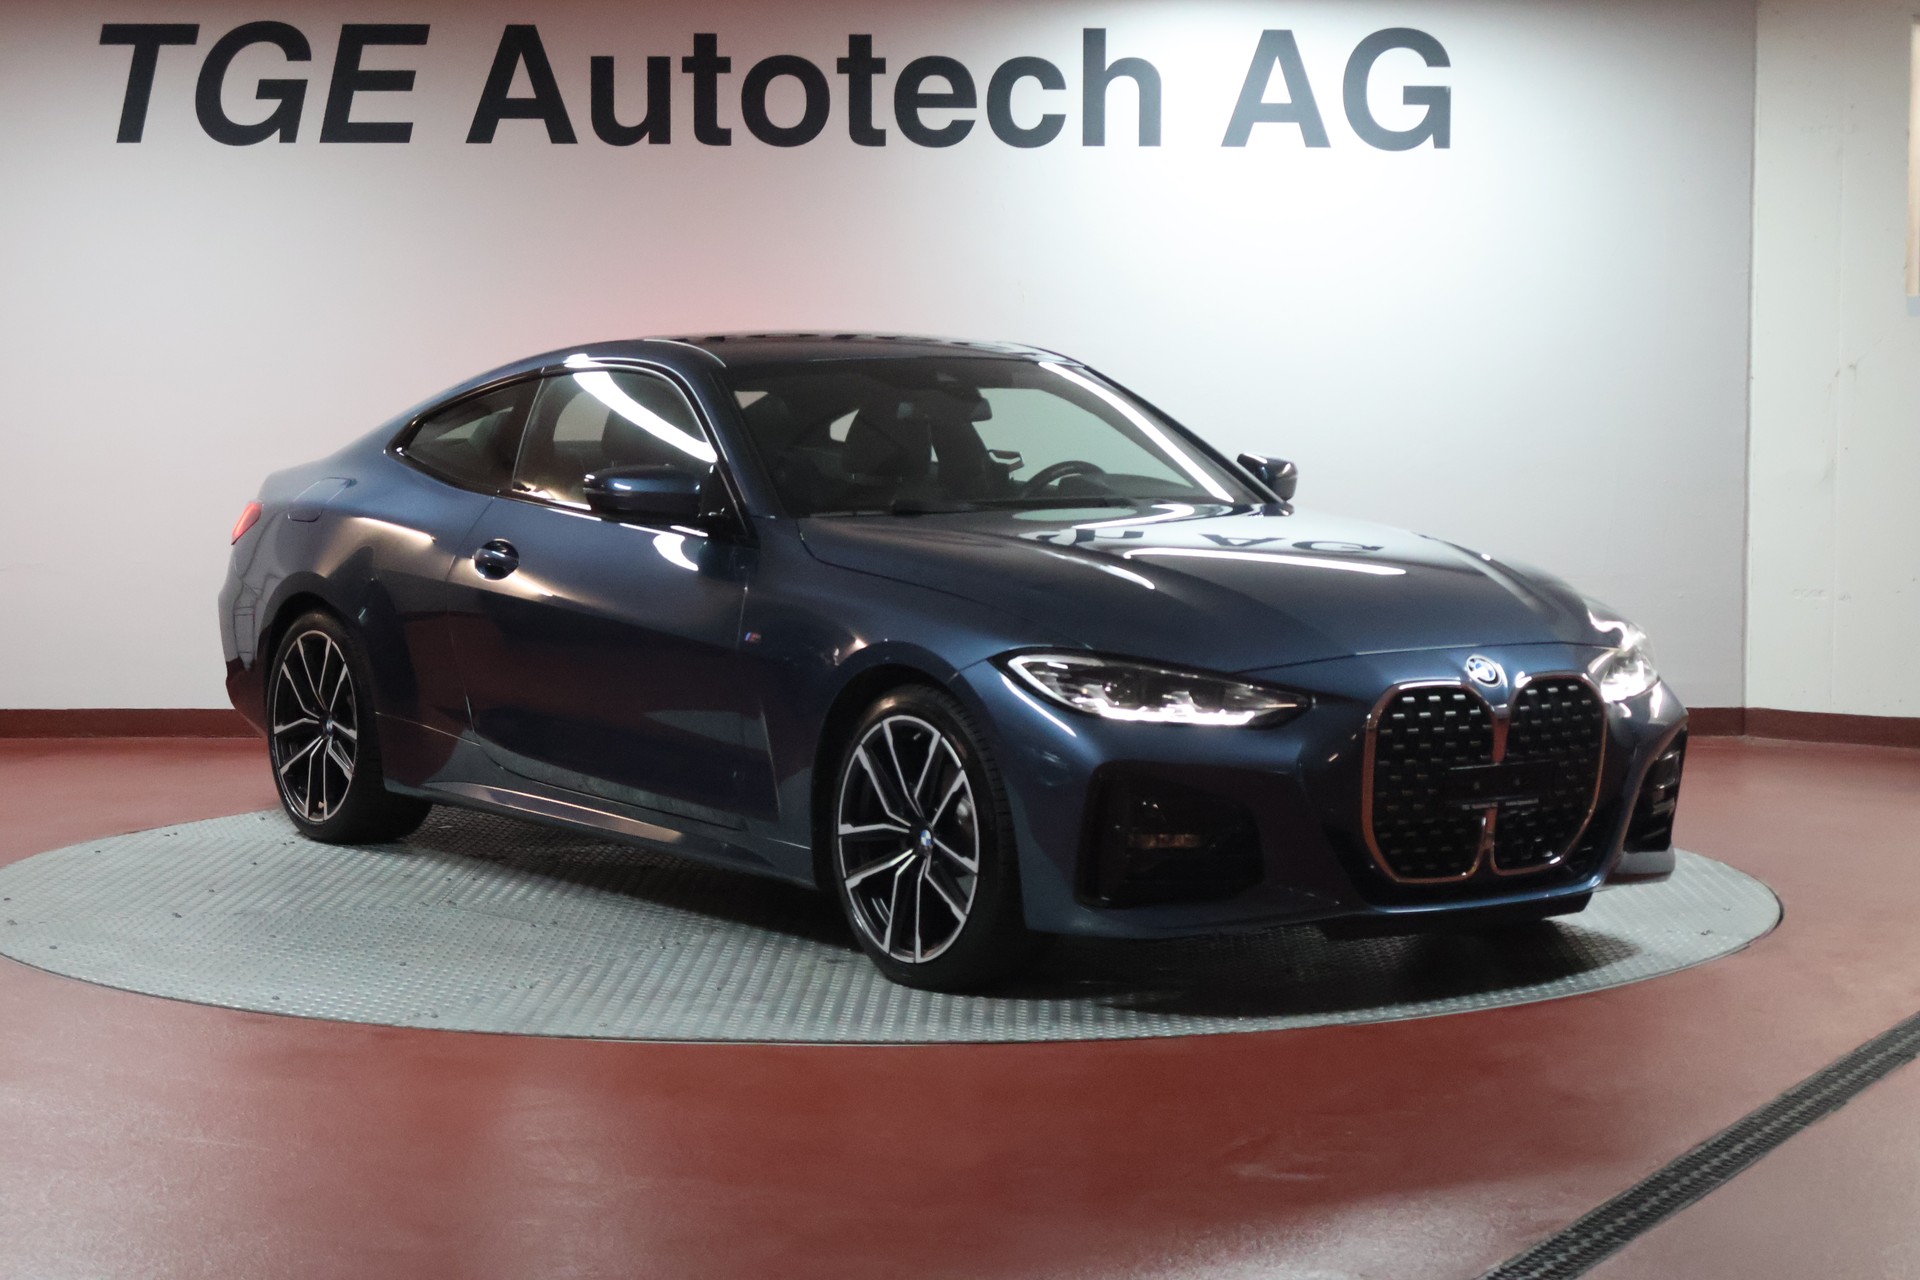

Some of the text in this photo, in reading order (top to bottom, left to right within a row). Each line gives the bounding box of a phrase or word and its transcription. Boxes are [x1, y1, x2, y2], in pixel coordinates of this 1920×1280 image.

[99, 21, 1452, 152] TGE Autotech AG
